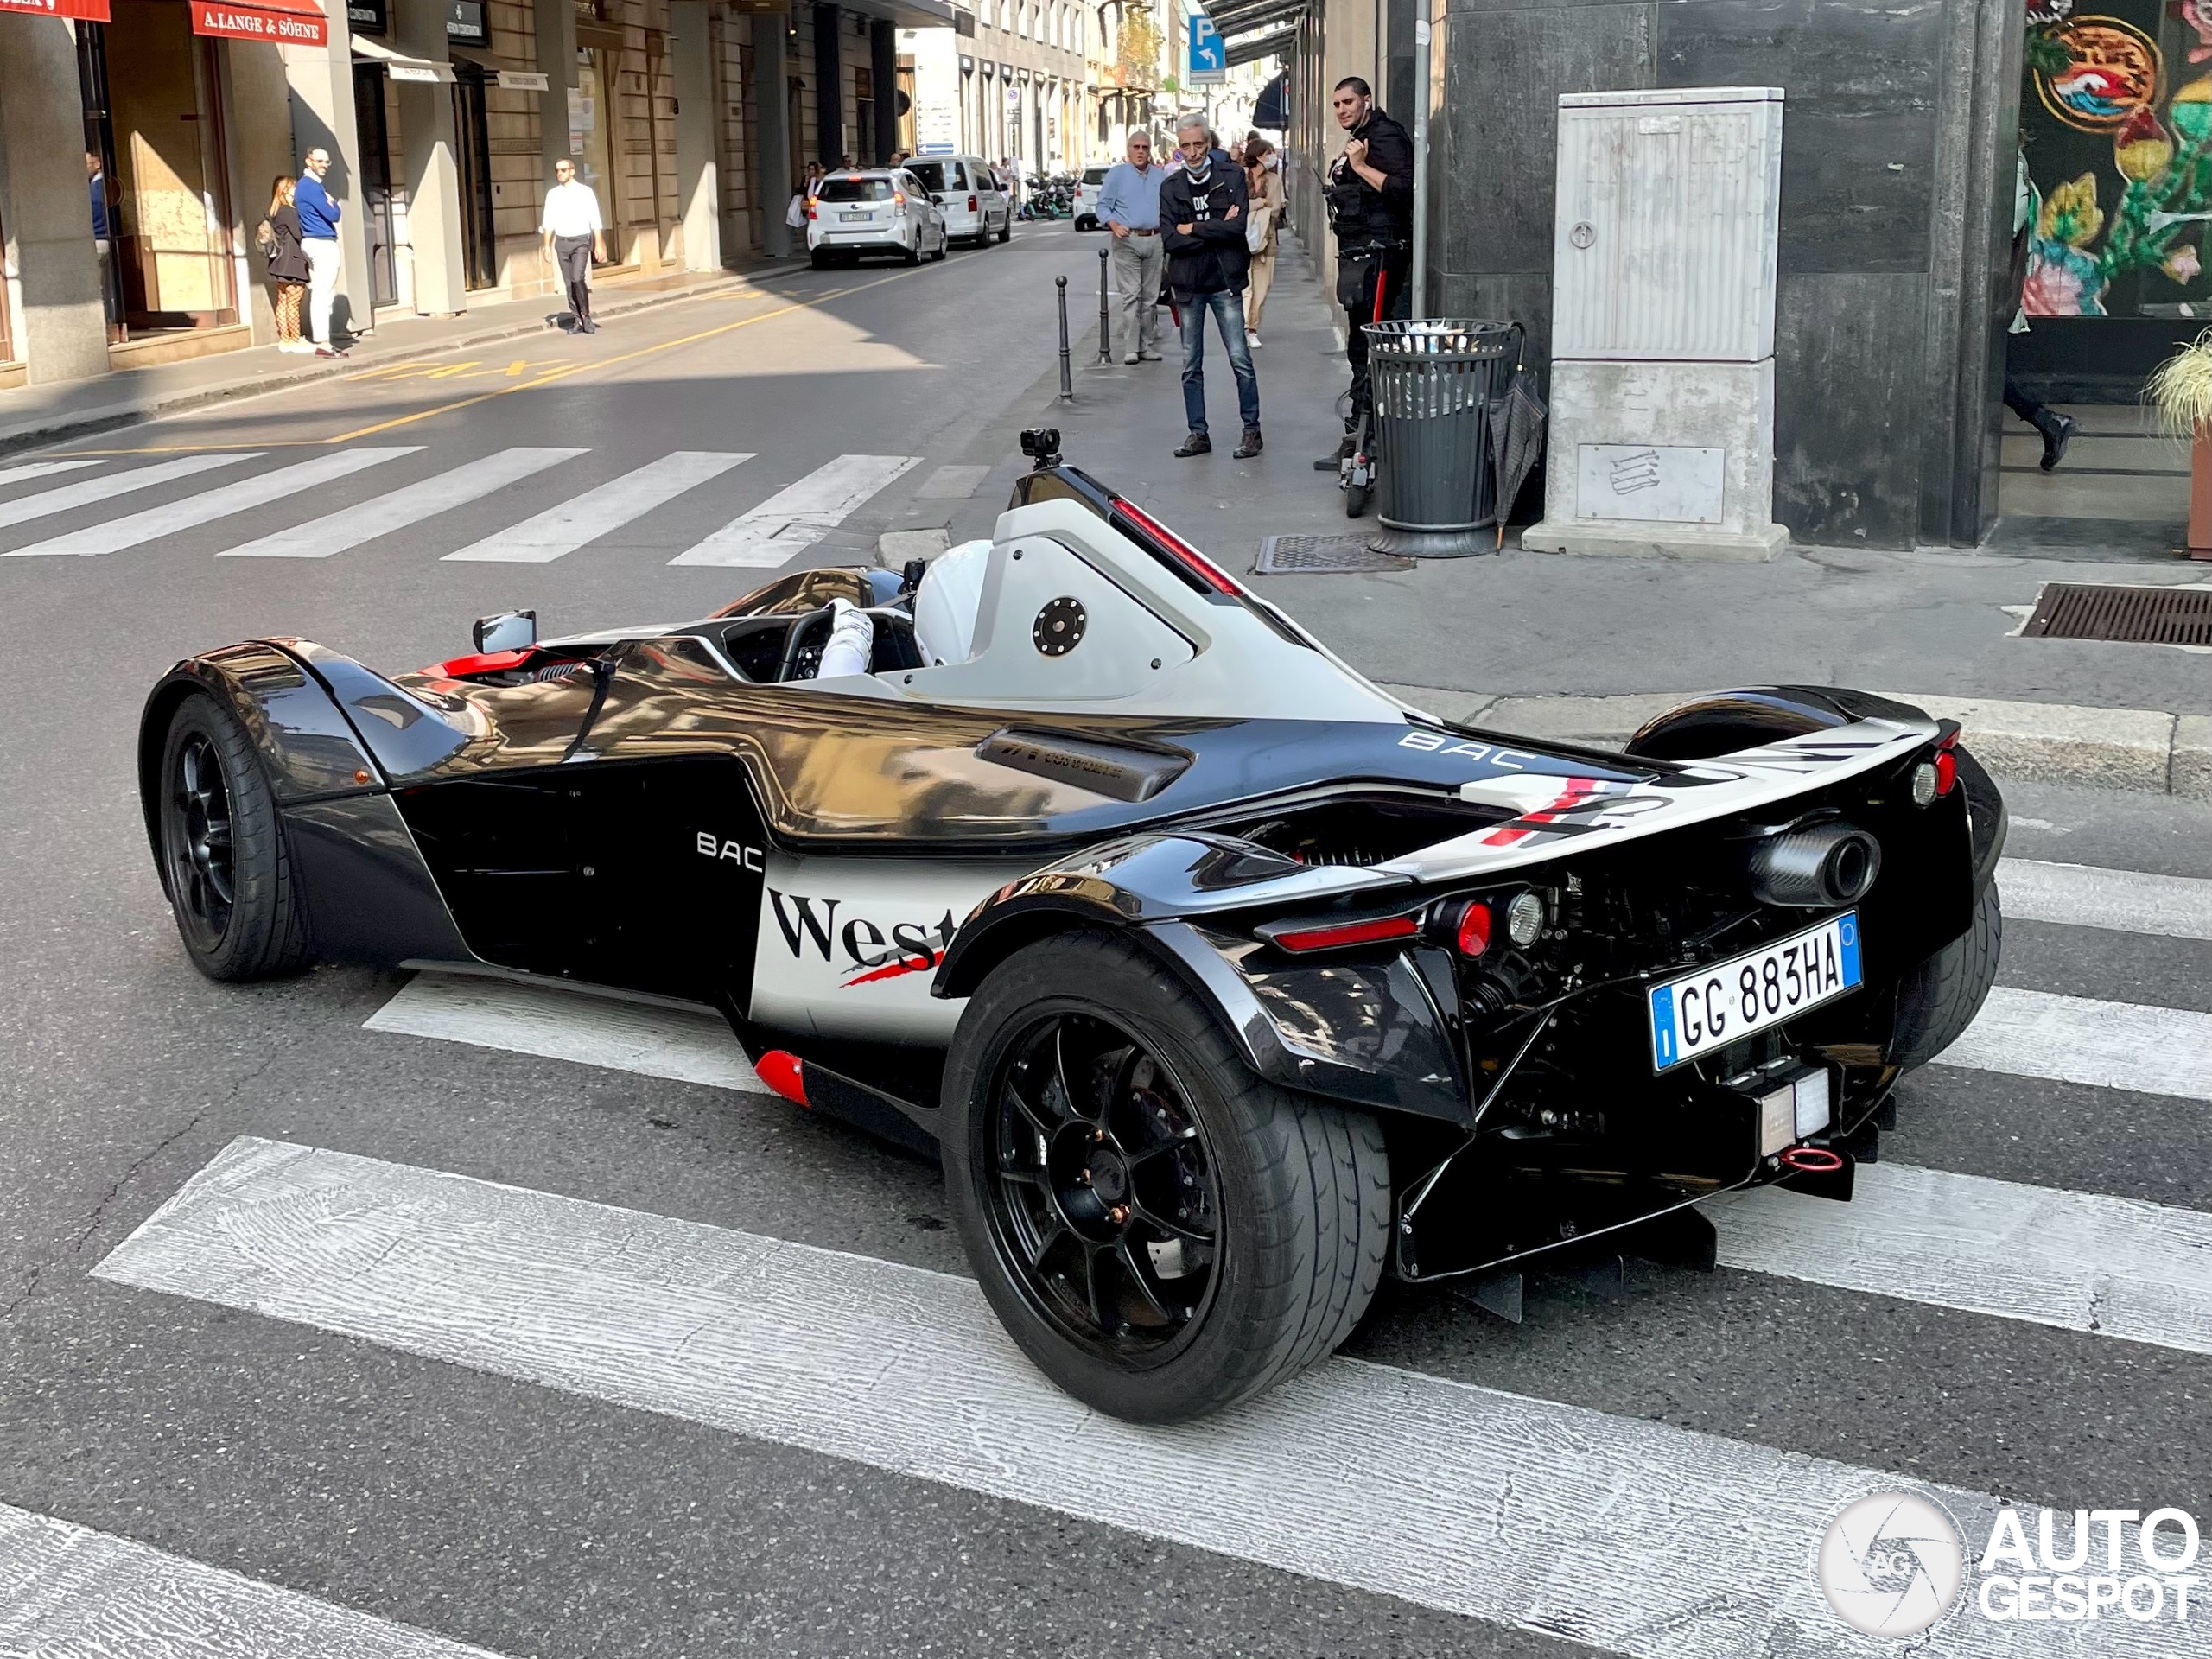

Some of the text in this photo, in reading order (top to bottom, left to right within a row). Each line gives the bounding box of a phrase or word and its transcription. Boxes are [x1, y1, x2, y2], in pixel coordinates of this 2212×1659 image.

[266, 18, 276, 34] &
[278, 17, 319, 39] SÖHNE
[1197, 18, 1215, 46] P
[1398, 732, 1536, 769] BAC
[697, 832, 762, 873] BAC
[1681, 932, 1839, 1046] GG 883HA
